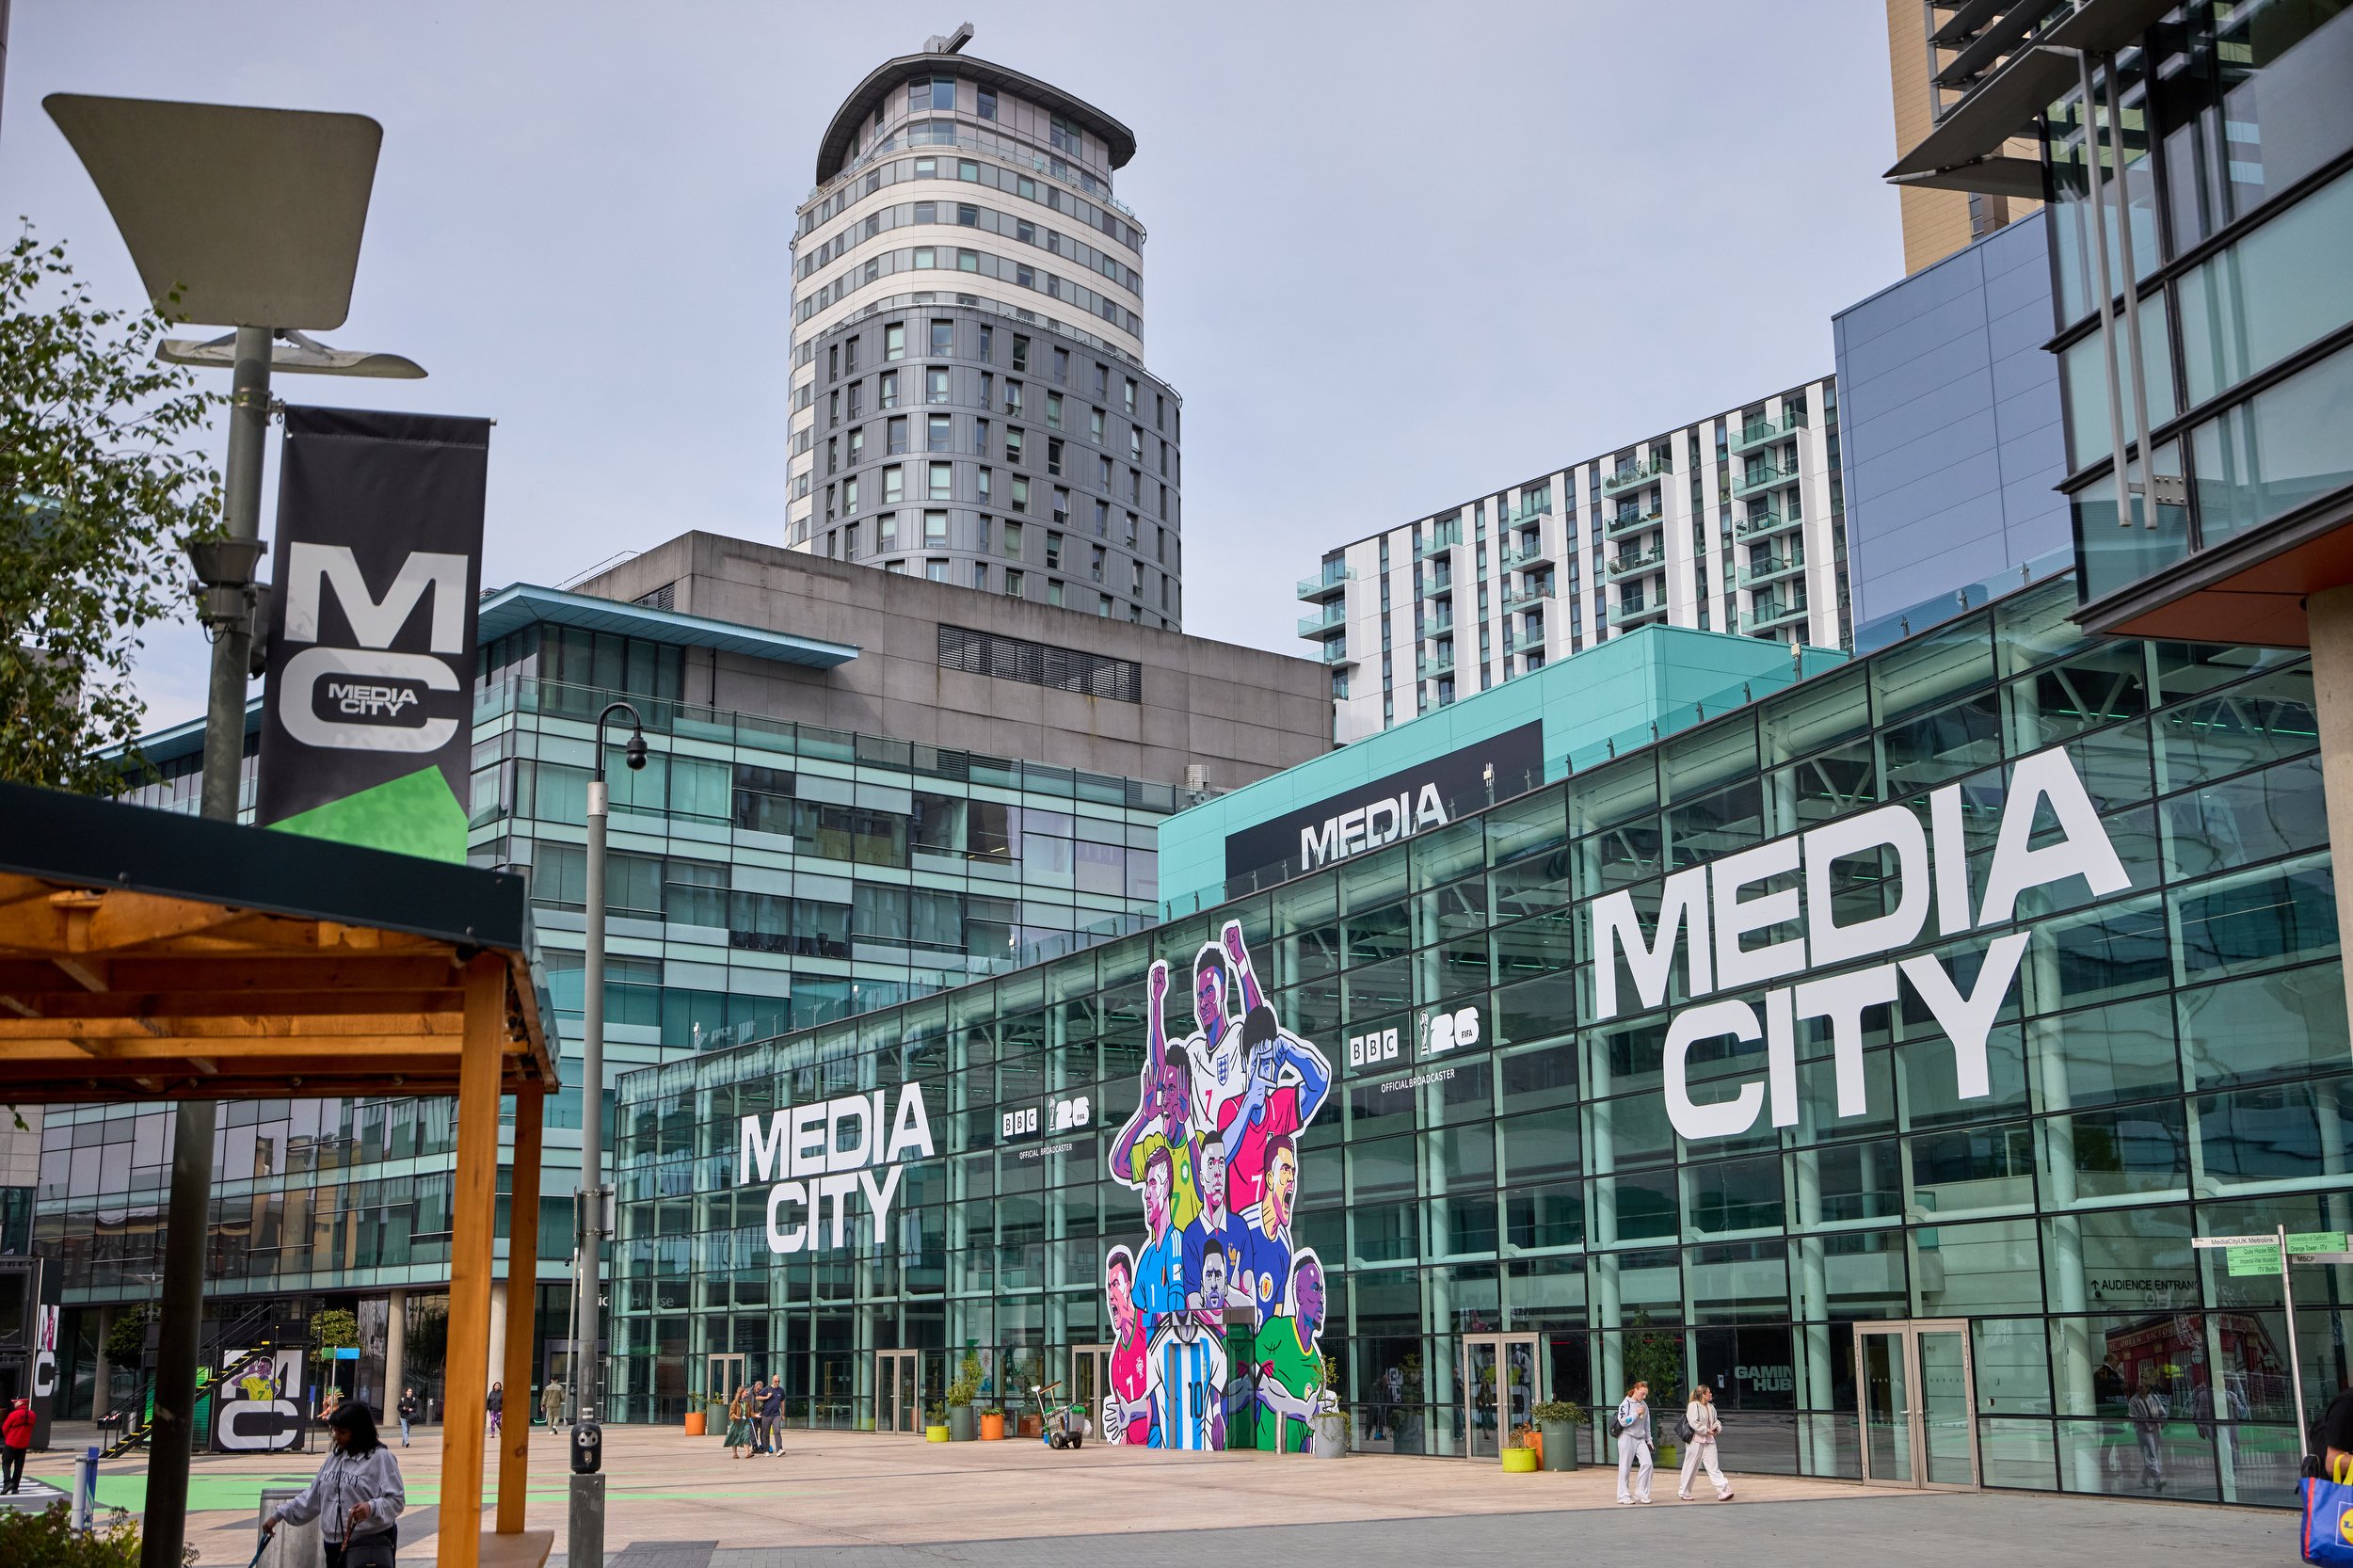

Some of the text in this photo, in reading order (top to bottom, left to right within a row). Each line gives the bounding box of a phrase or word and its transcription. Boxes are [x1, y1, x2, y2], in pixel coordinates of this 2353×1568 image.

[283, 541, 469, 654] M
[279, 647, 460, 753] C
[328, 683, 419, 704] MEDIA
[340, 698, 404, 716] CITY
[1301, 782, 1449, 871] MEDIA
[1593, 745, 2133, 1020] MEDIA
[1430, 1006, 1480, 1054] 26
[1461, 1030, 1473, 1039] FIFA
[1663, 931, 2031, 1140] CITY
[1352, 1032, 1396, 1064] BBC
[1381, 1068, 1455, 1094] OFFICIAL BROADCASTER
[1004, 1111, 1035, 1134] BBC
[1056, 1096, 1089, 1129] 26
[740, 1081, 935, 1184] MEDIA
[1019, 1144, 1073, 1160] OFFICIAL BROADCASTER
[766, 1164, 904, 1254] CITY
[2211, 1238, 2248, 1246] MediaCityUK
[2102, 1280, 2152, 1290] AUDIENCE
[1735, 1366, 1808, 1380] GAMIN
[1753, 1378, 1792, 1391] HUB
[1188, 1381, 1204, 1419] 10
